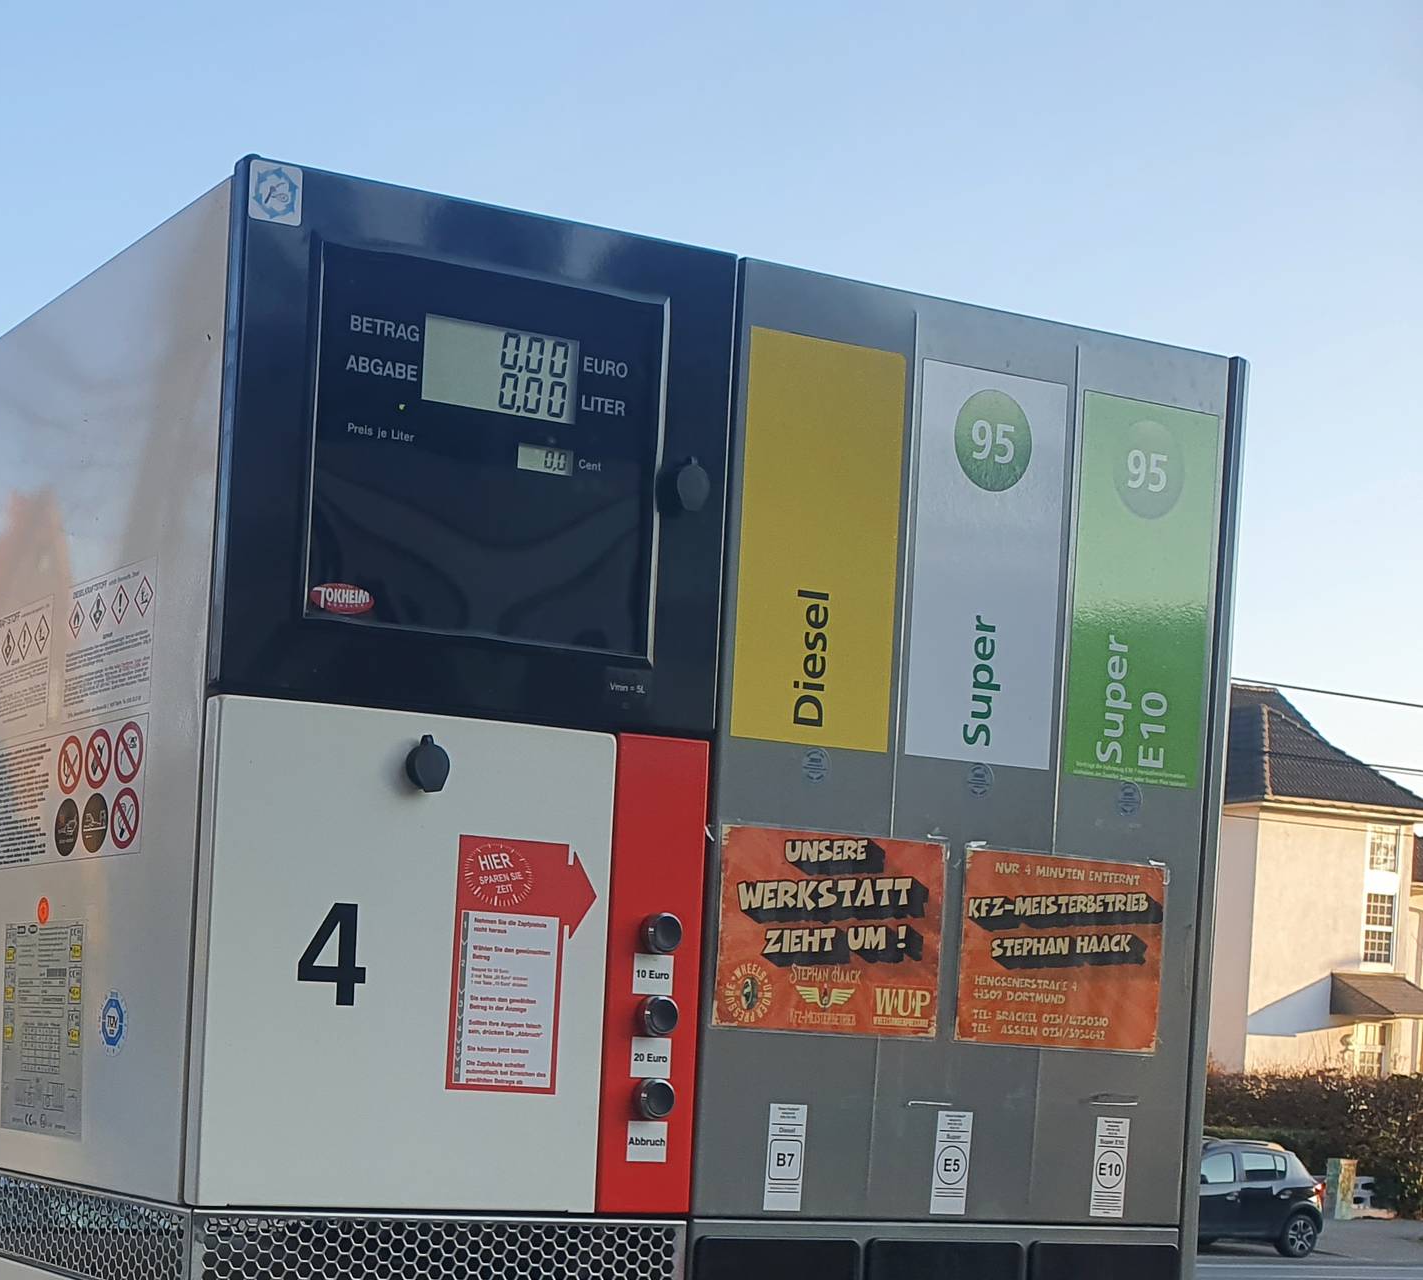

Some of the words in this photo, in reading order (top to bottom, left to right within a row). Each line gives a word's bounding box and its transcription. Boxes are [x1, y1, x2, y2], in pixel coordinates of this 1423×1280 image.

[350, 314, 420, 342] BETRAG
[500, 332, 569, 379] 0,00
[583, 356, 628, 378] EURO
[345, 355, 418, 381] ABGABE
[498, 372, 567, 418] 0,00
[581, 394, 626, 416] LITER
[347, 423, 373, 437] Preis
[377, 426, 388, 439] je
[391, 429, 415, 443] Liter
[971, 420, 1015, 464] 95
[579, 459, 601, 472] Cent
[1127, 449, 1168, 492] 95
[313, 586, 370, 609] TOKHEIM
[793, 589, 829, 728] Diesel
[963, 614, 1001, 748] Super
[1096, 633, 1132, 764] Super
[1138, 691, 1168, 769] E10
[478, 853, 514, 871] HIER
[785, 839, 868, 863] UNSERE
[479, 873, 510, 885] SPAREN
[510, 872, 524, 880] SIE
[995, 862, 1020, 874] NUR
[1025, 863, 1031, 875] 4
[1036, 866, 1085, 882] MINUTEN
[1089, 871, 1140, 886] ENTFERNT
[496, 884, 514, 894] ZEIT
[737, 877, 912, 911] WERKSTATT
[968, 892, 1149, 918] KFZ-MEISTERBETRIEB
[763, 927, 836, 955] ZIEHT
[847, 926, 886, 950] UM
[896, 925, 907, 949] !
[991, 936, 1070, 958] STEPHAN
[1076, 934, 1132, 954] HAACK
[297, 902, 367, 1006] 4
[636, 969, 647, 979] 10
[649, 969, 670, 980] Euro
[789, 964, 828, 985] STEPHAN
[831, 966, 862, 985] HAACK
[1006, 990, 1066, 1004] DORTMUND
[972, 1009, 992, 1020] TEL:
[995, 1010, 1038, 1023] BRACKEL
[972, 1023, 991, 1034] TEL:
[1001, 1024, 1038, 1037] ASSELN
[633, 1052, 645, 1063] 20
[646, 1053, 668, 1063] Euro
[628, 1136, 666, 1148] Abbruch
[776, 1152, 795, 1167] B7
[943, 1158, 960, 1172] E5
[1098, 1162, 1122, 1177] E10
